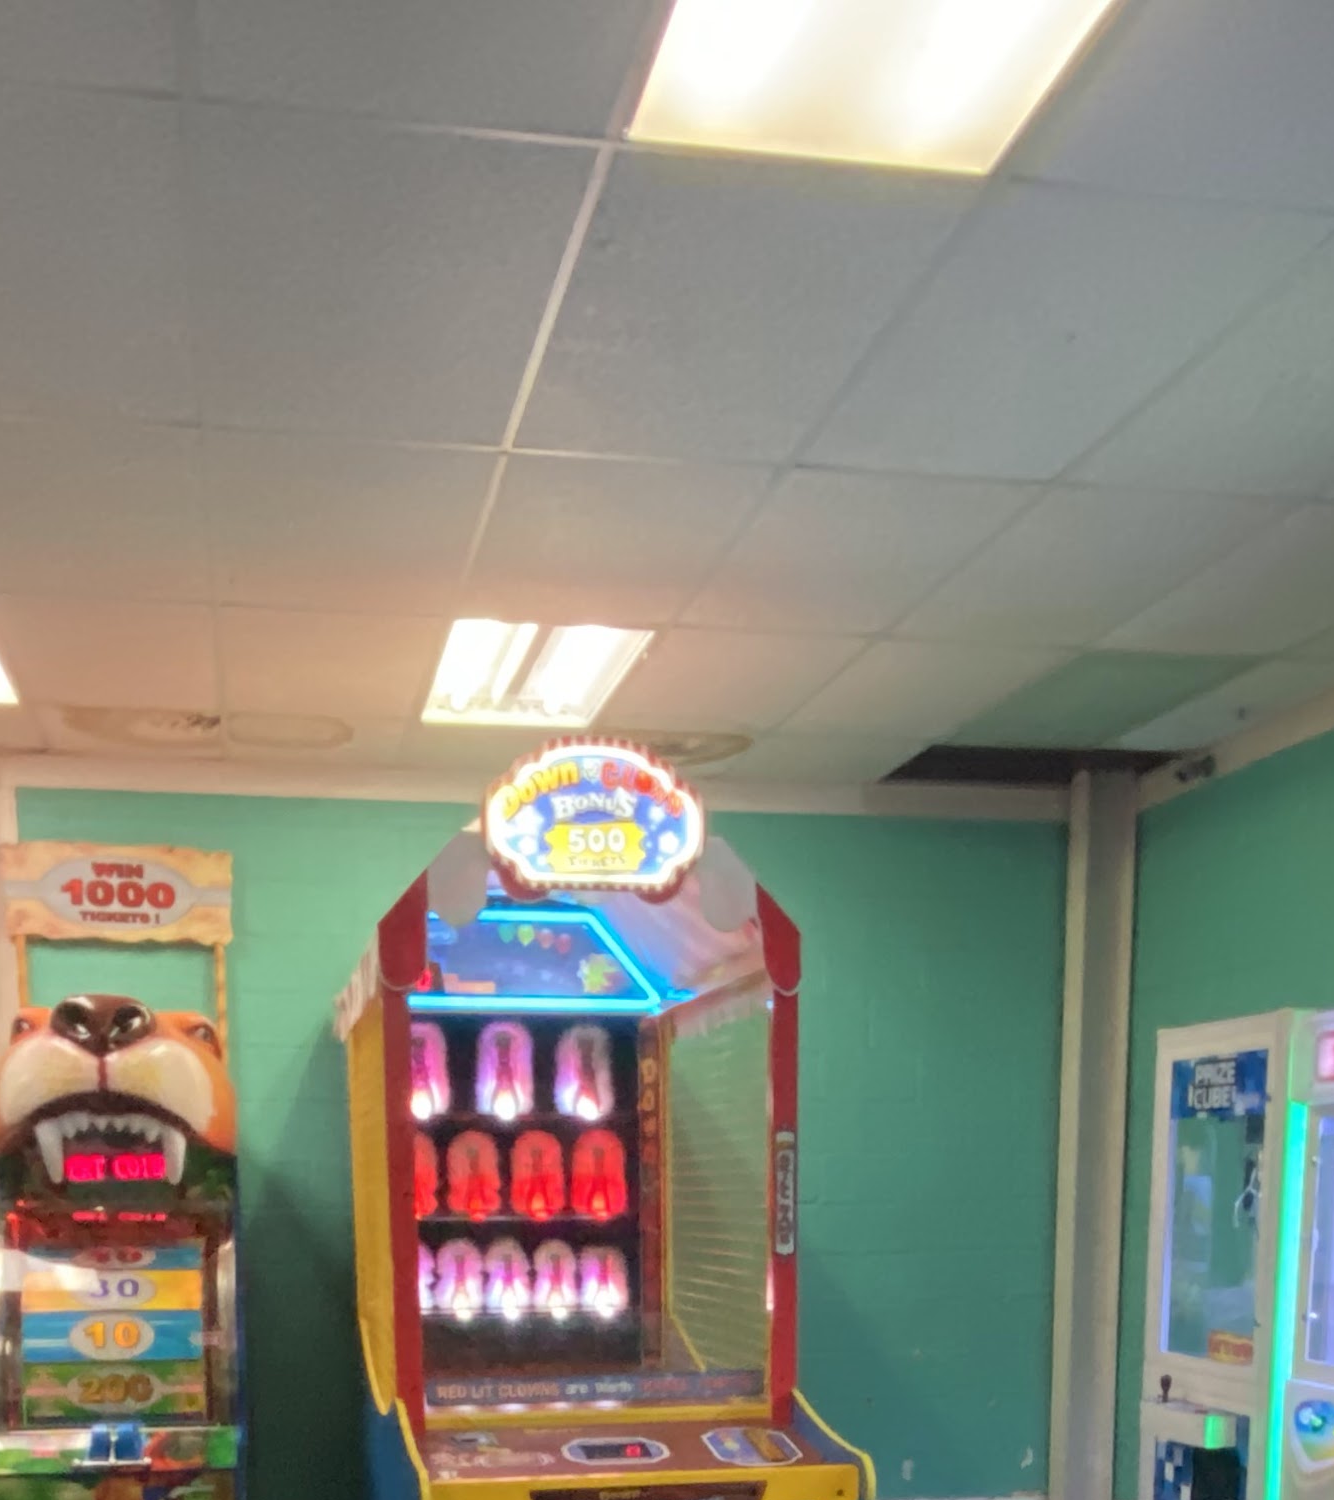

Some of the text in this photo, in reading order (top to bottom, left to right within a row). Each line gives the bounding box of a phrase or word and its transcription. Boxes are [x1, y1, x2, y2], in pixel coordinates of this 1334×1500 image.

[567, 828, 626, 853] 500
[91, 862, 144, 879] WIN
[62, 881, 176, 909] 1000
[80, 911, 151, 924] TICKETS
[1195, 1061, 1236, 1087] PRIZE
[90, 1278, 140, 1299] 30
[83, 1321, 141, 1349] 10
[77, 1374, 154, 1404] 200
[436, 1385, 466, 1399] RED
[471, 1385, 494, 1399] LIT
[498, 1382, 559, 1398] CLOWNS
[565, 1383, 588, 1395] are
